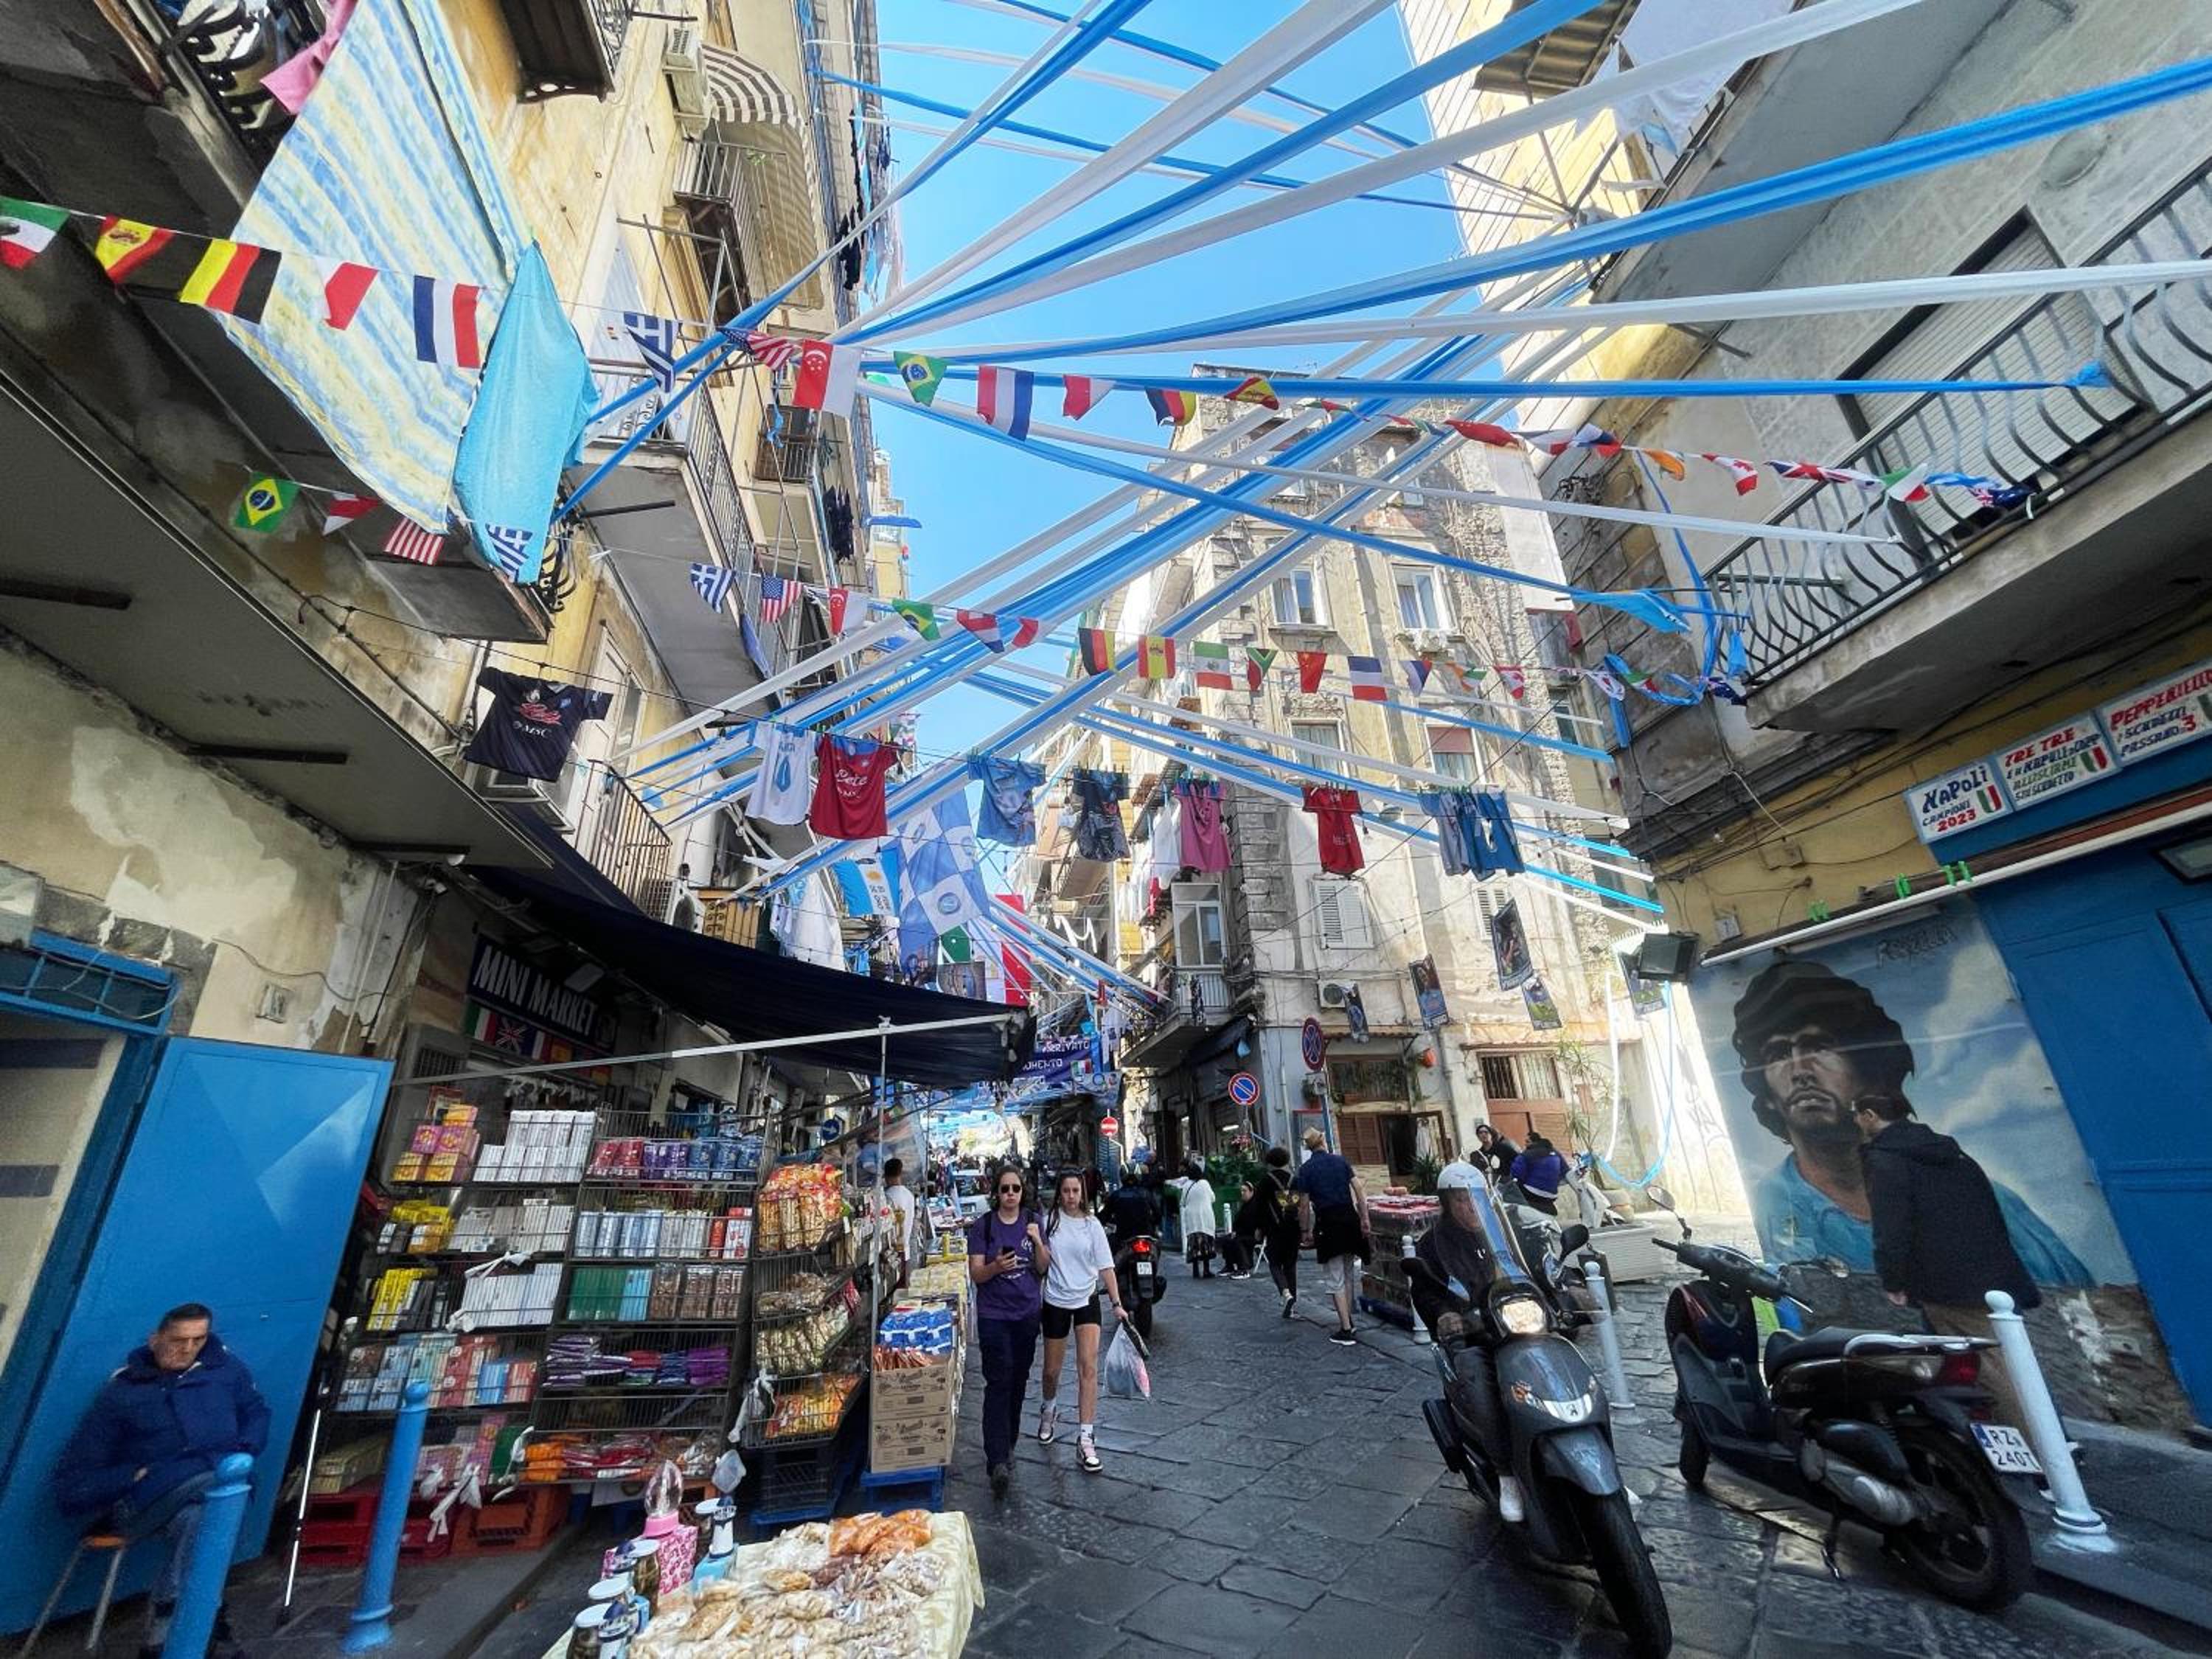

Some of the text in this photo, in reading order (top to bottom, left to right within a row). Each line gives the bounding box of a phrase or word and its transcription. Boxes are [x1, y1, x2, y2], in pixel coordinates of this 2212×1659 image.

[2005, 726, 2075, 768] TRE TRE
[1937, 808, 1977, 832] 2023
[473, 945, 598, 1036] MINI MARKET
